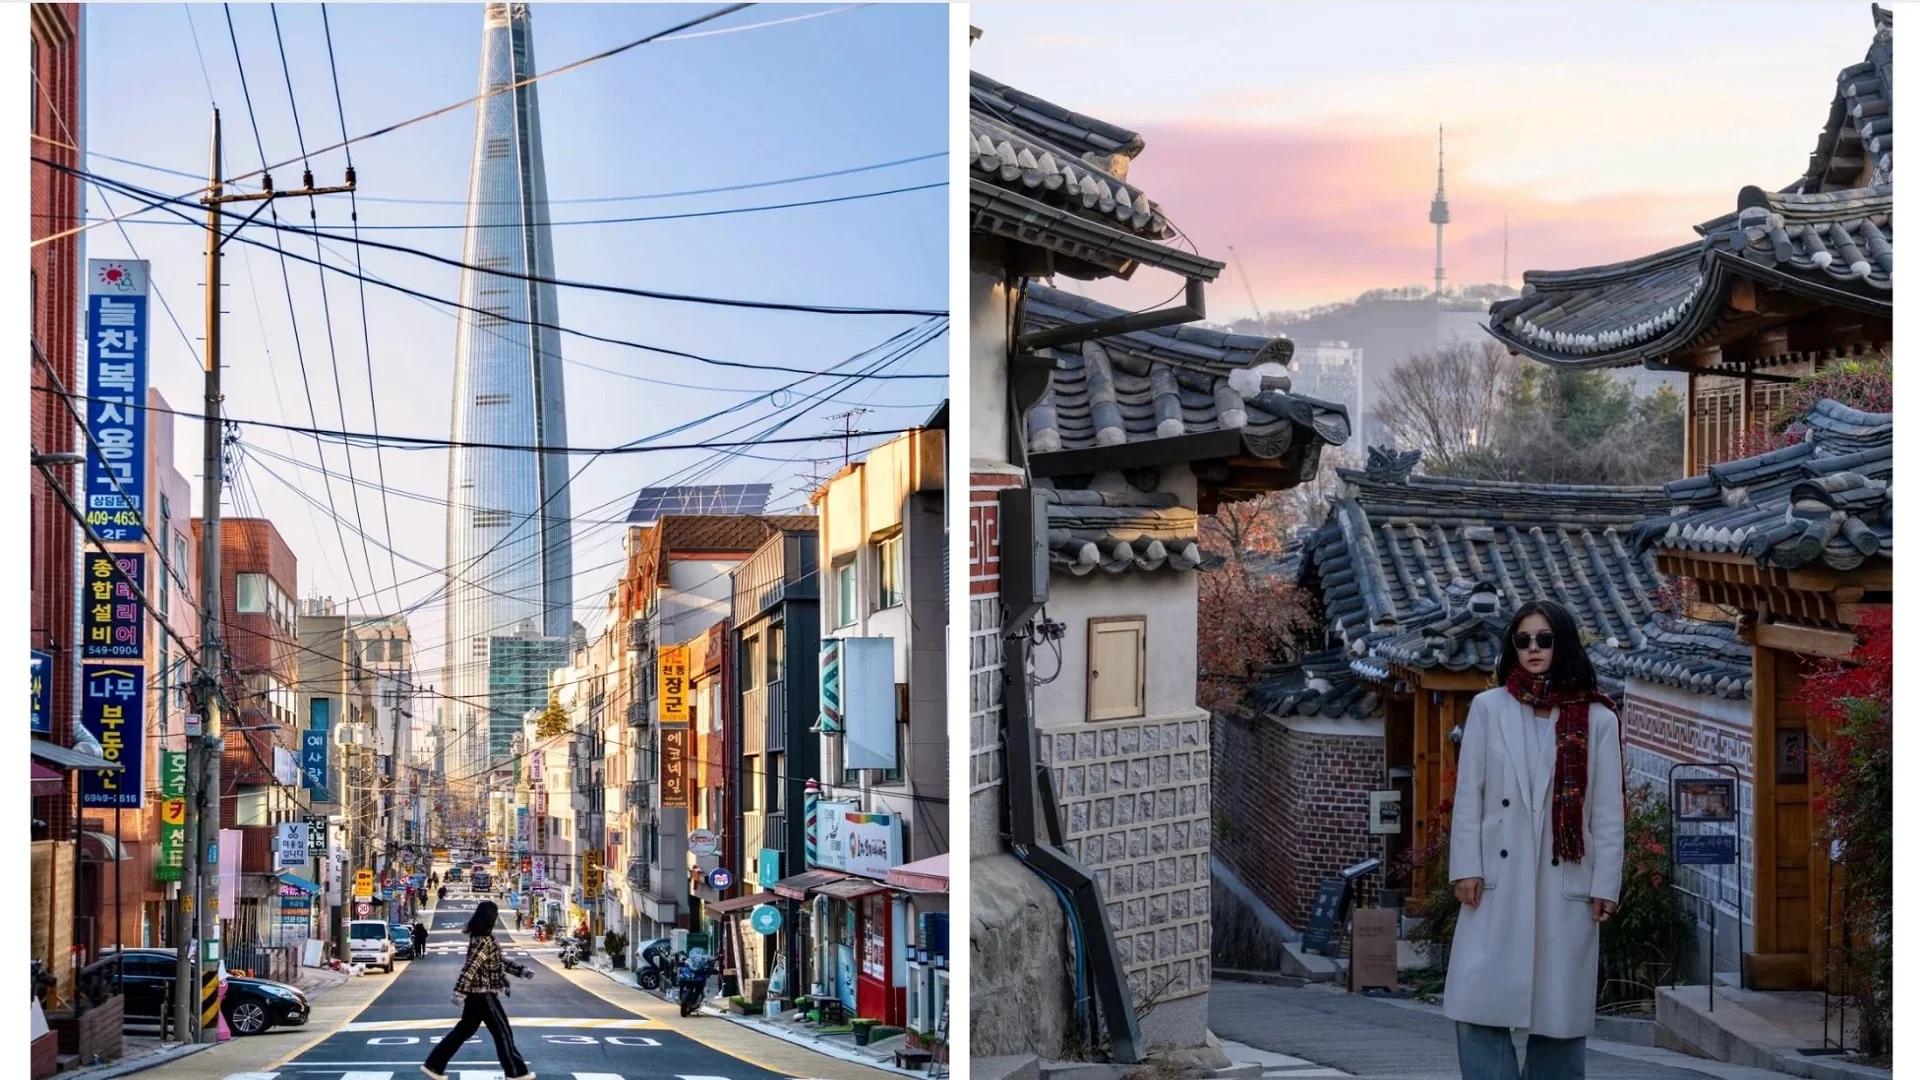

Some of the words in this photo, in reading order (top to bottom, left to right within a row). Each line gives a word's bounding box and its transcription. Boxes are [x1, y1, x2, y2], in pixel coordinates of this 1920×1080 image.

[96, 297, 138, 492] 늘찬복지용구
[103, 529, 127, 540] 2F
[92, 559, 113, 644] 종합설비
[115, 559, 137, 646] 인테리어
[88, 645, 138, 656] 549-0904
[90, 677, 136, 701] 나무
[665, 677, 684, 713] 장군
[97, 704, 125, 790] 부동산
[307, 735, 323, 783] 예사랑
[667, 731, 682, 794] 에코네일
[541, 1034, 663, 1047] 30
